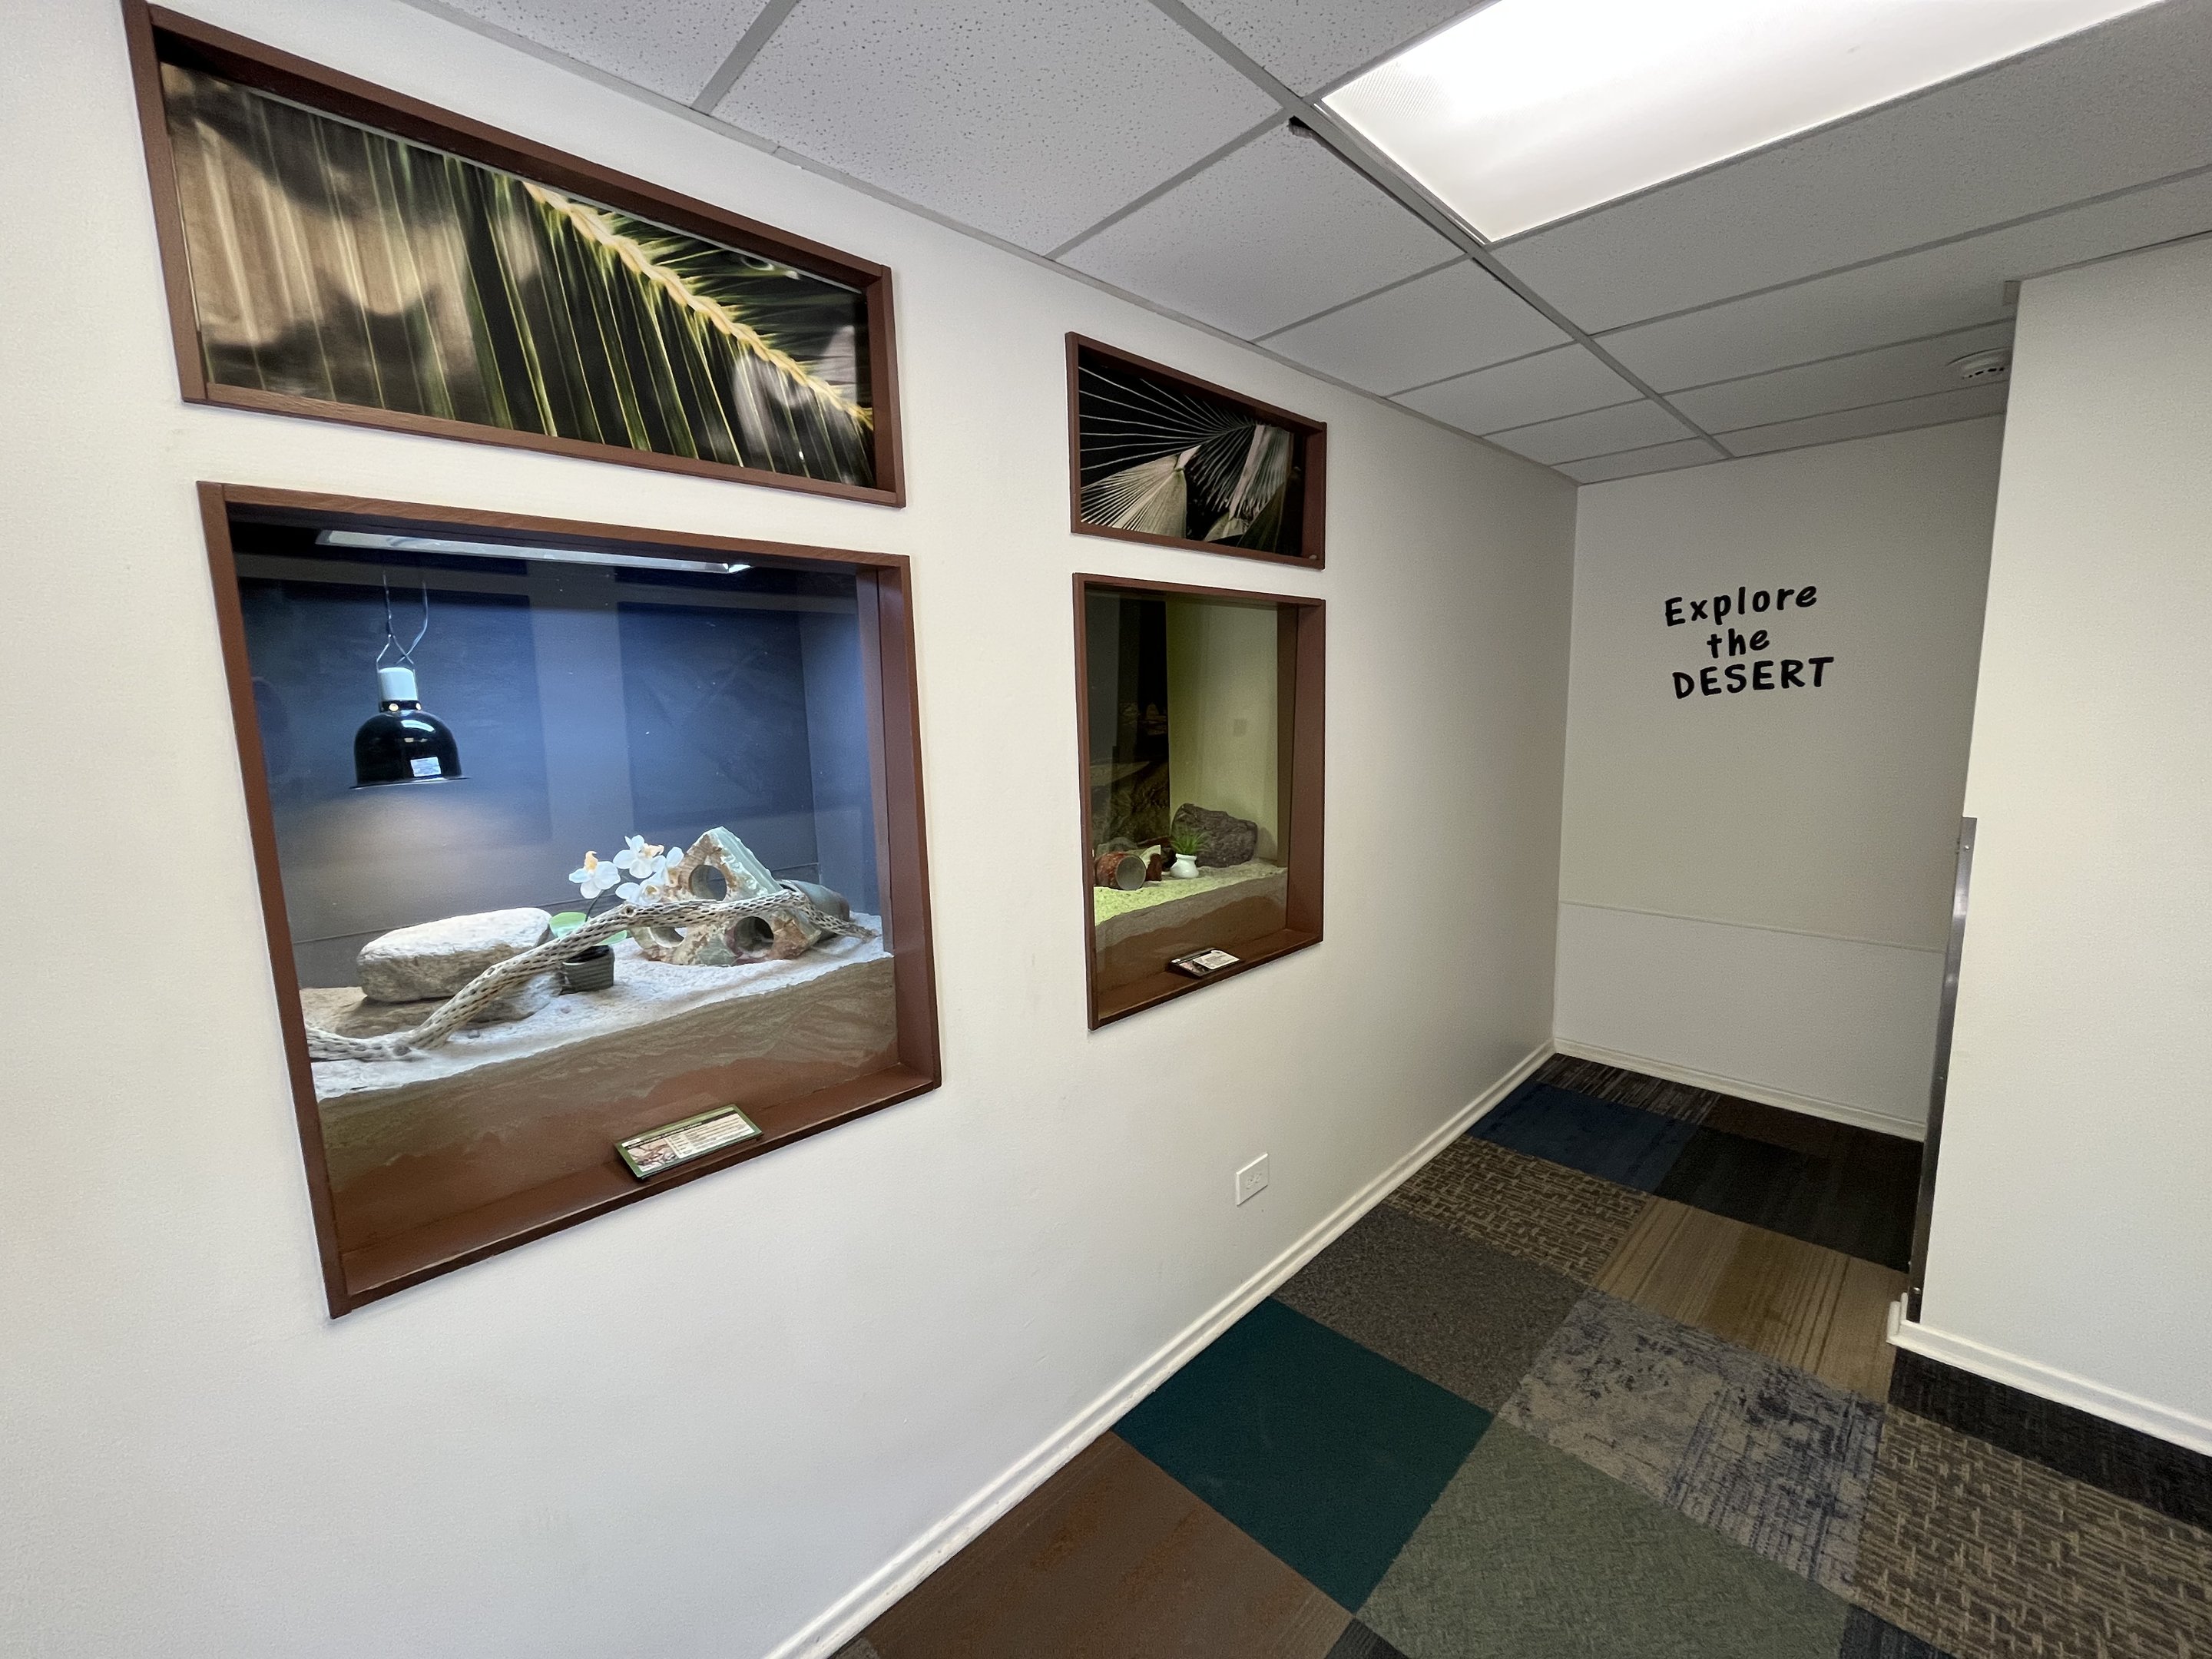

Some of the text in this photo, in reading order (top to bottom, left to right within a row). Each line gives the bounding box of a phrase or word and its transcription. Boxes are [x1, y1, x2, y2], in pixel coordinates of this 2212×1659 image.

[1664, 585, 1817, 627] Explore
[1706, 628, 1770, 659] the
[1672, 656, 1835, 700] DESERT
